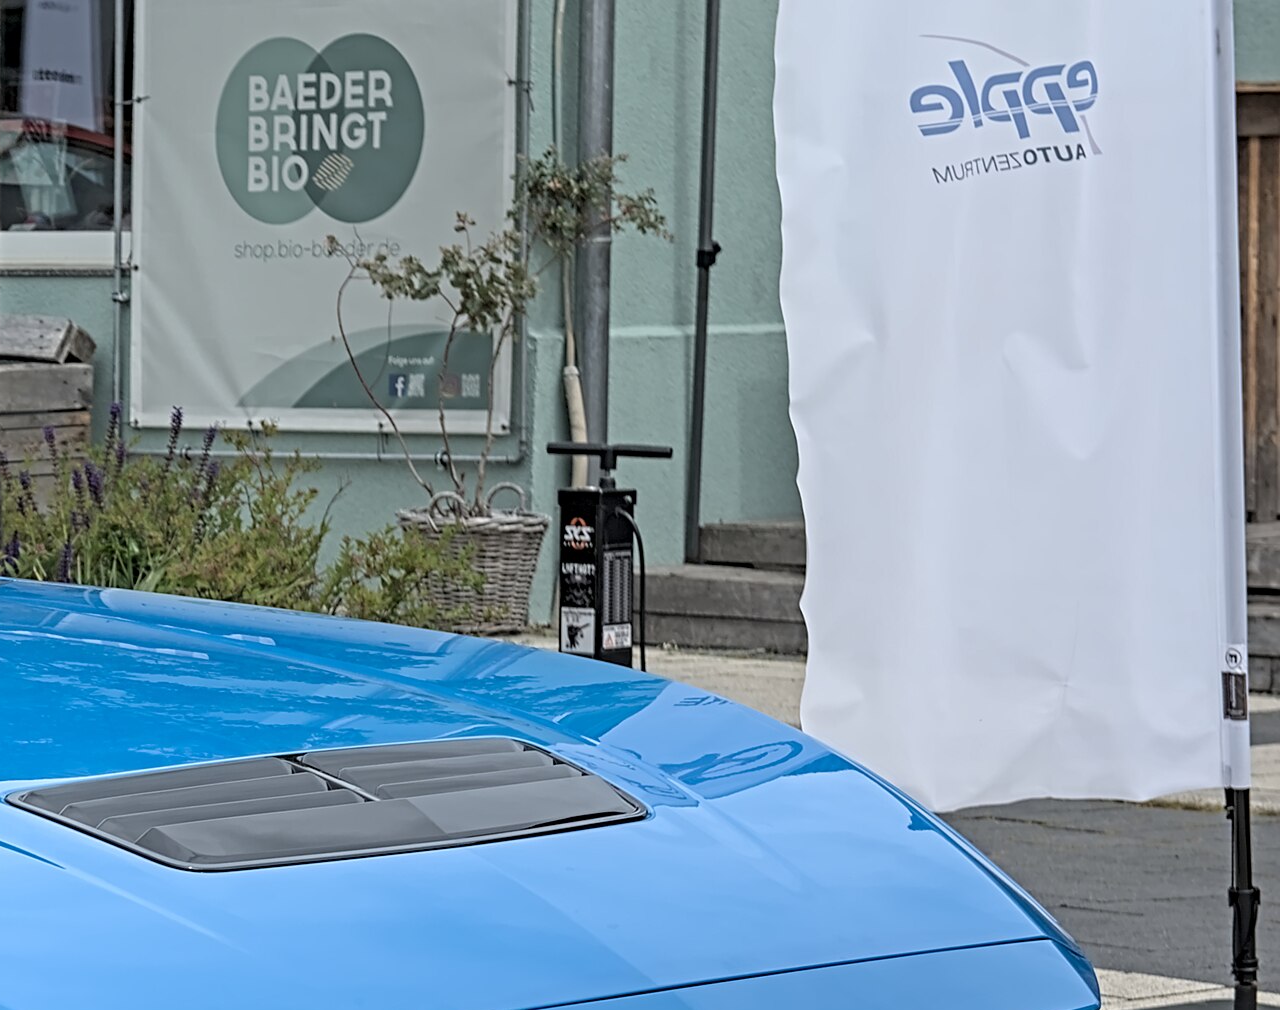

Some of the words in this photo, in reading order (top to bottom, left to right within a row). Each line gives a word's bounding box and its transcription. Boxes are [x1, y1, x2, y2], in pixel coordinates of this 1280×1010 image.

[248, 70, 393, 112] BAEDER
[247, 111, 388, 152] BRINGT
[247, 155, 309, 192] BIO
[234, 239, 401, 262] shop.bio-bderde
